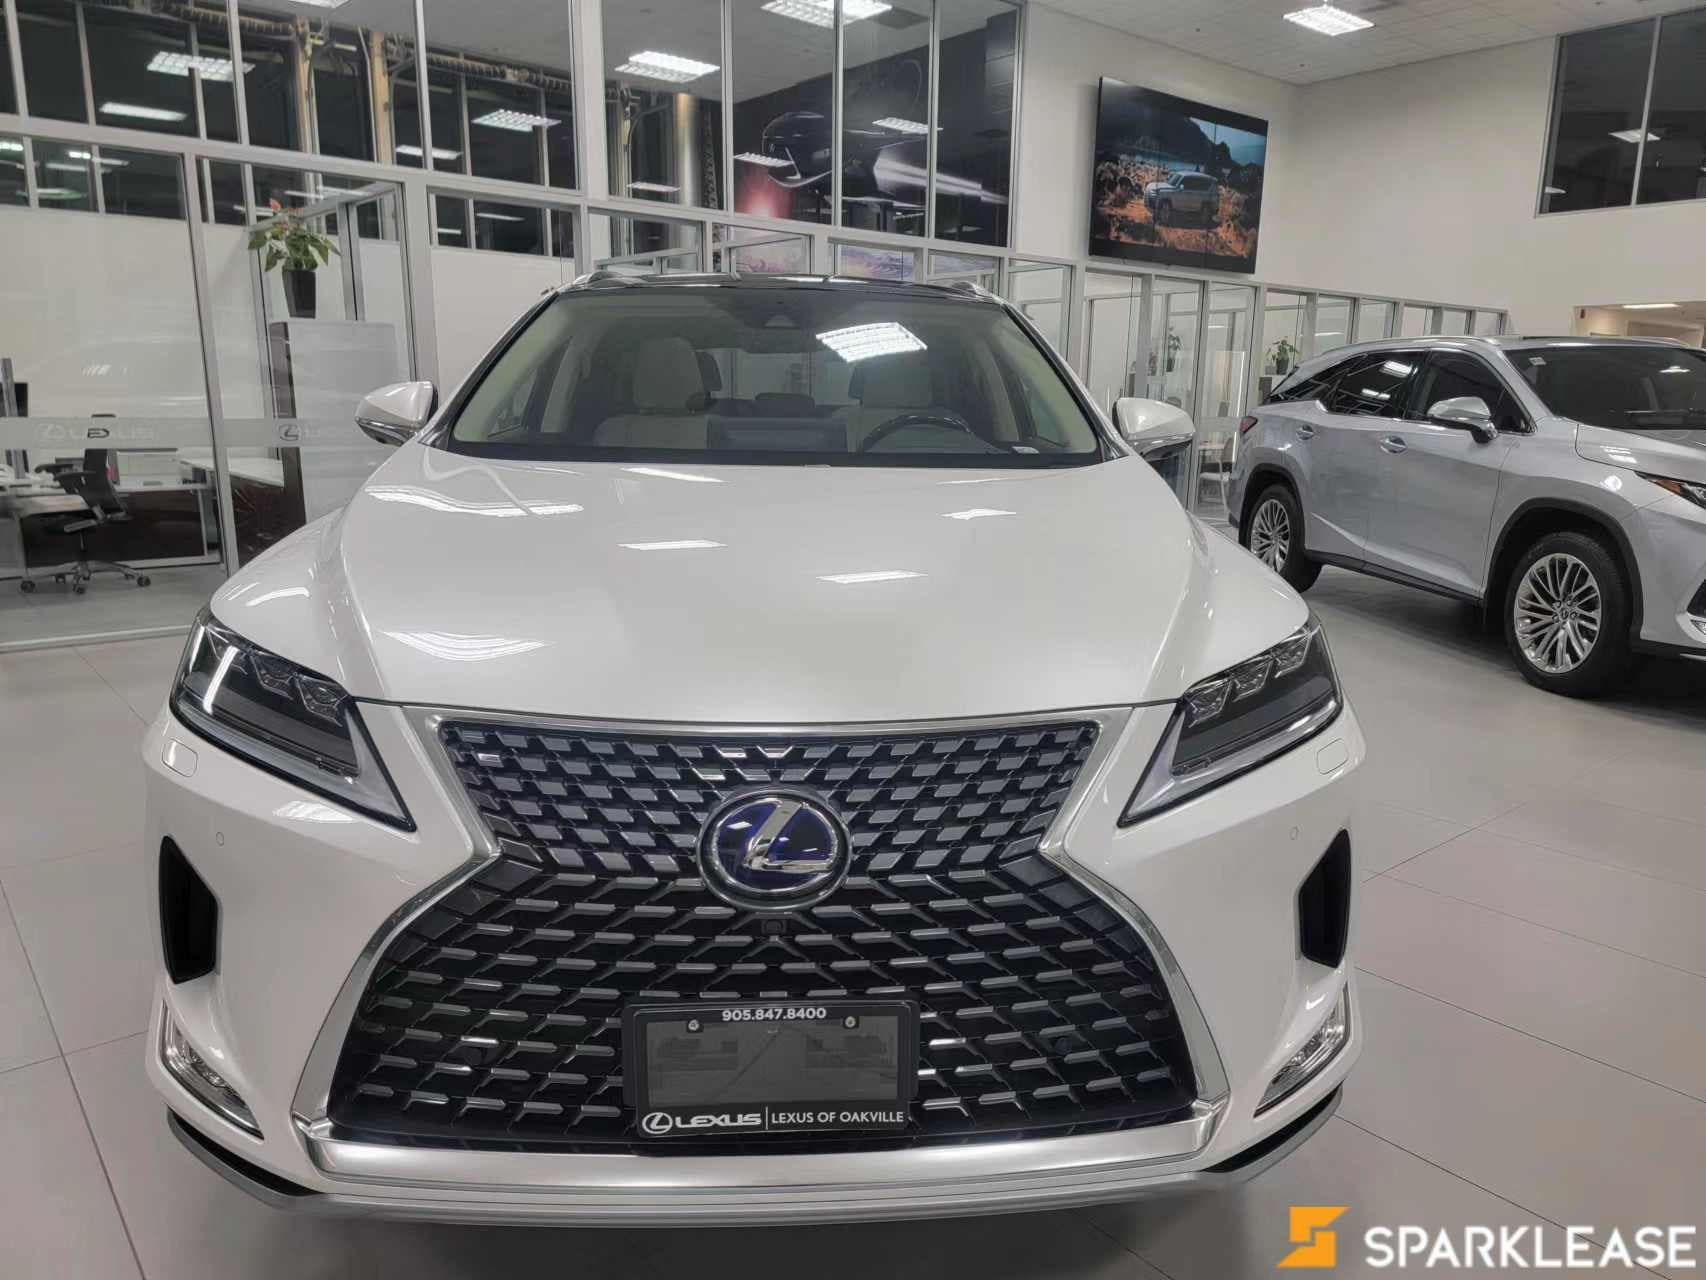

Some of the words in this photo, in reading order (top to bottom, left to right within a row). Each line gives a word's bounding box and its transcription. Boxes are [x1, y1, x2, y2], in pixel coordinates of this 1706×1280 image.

[721, 1007, 827, 1021] 905.847.8400
[675, 1113, 762, 1130] LEXUS
[771, 1112, 815, 1124] LEXUS
[817, 1111, 836, 1124] OF
[839, 1110, 904, 1123] OAKVILLE
